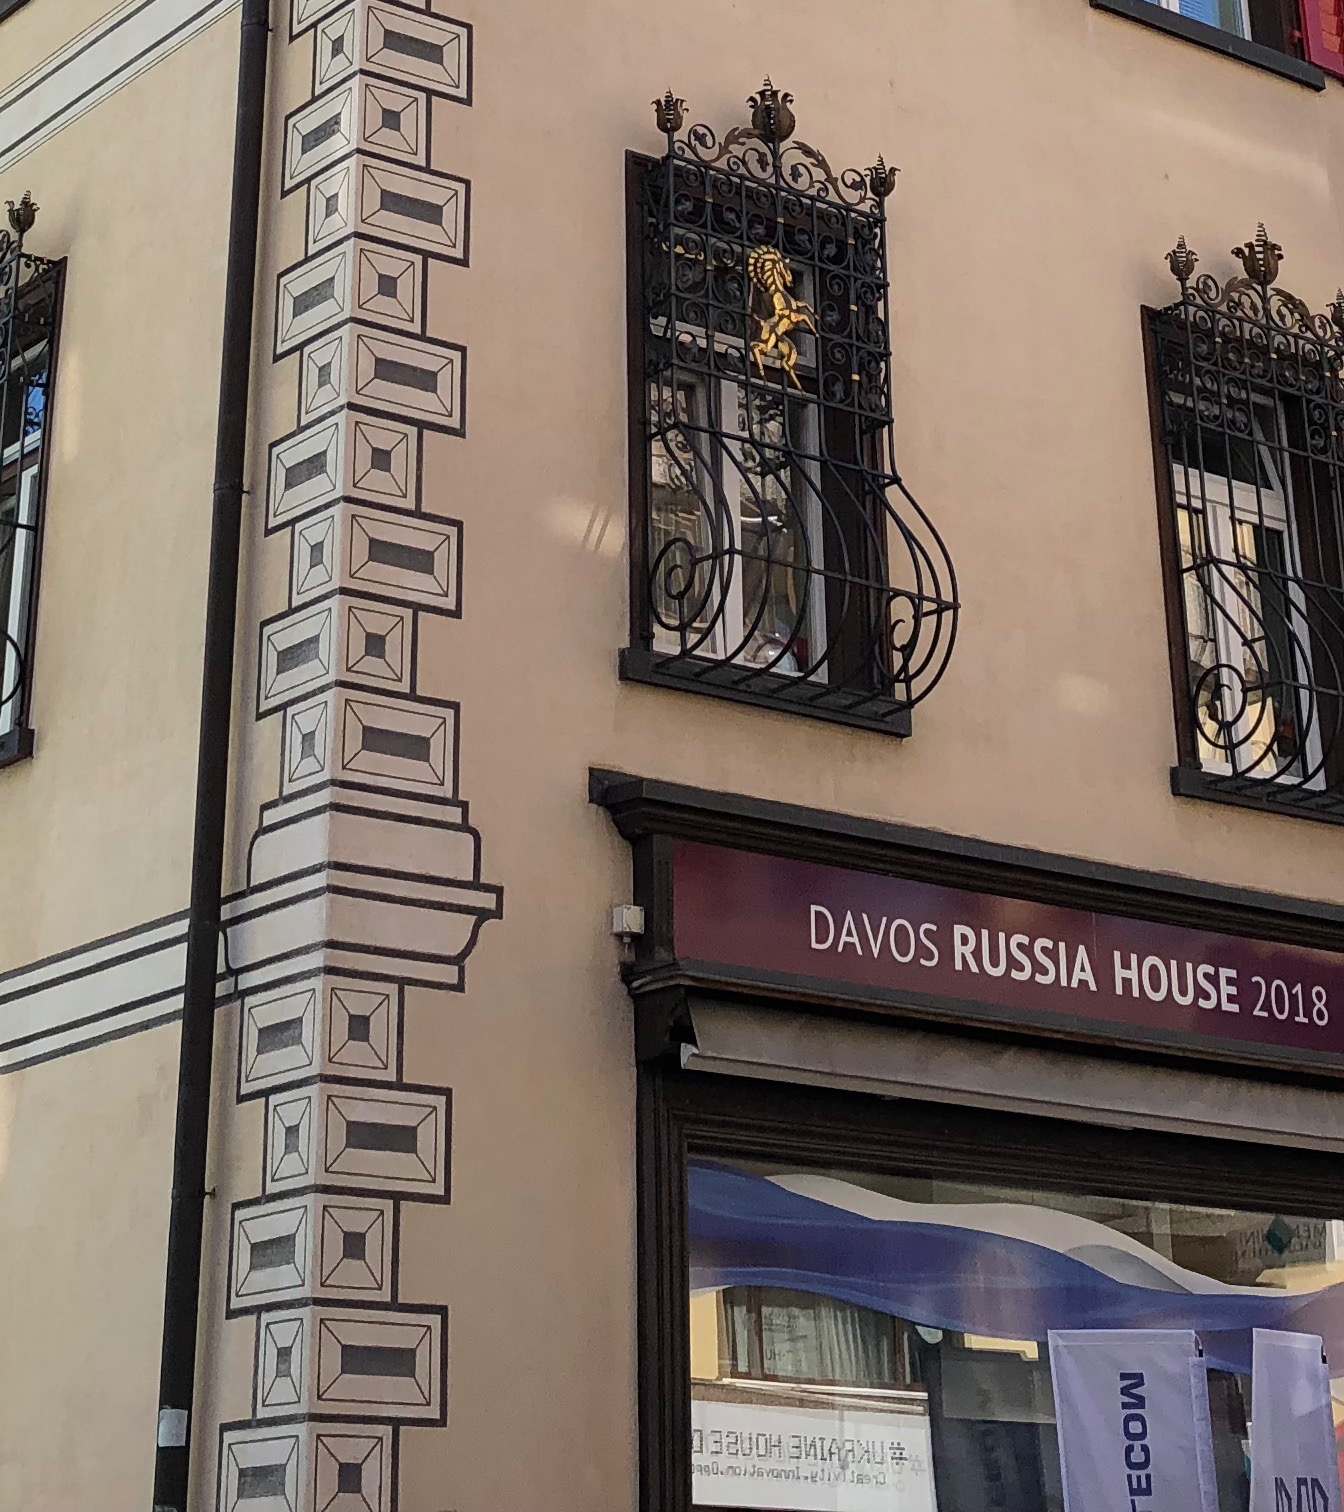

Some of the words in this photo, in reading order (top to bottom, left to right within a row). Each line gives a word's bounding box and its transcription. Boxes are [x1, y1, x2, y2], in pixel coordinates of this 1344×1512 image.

[808, 904, 940, 968] DAVOS
[952, 924, 1097, 992] RUSSIA
[1113, 950, 1241, 1014] HOUSE
[1250, 976, 1330, 1027] 2018
